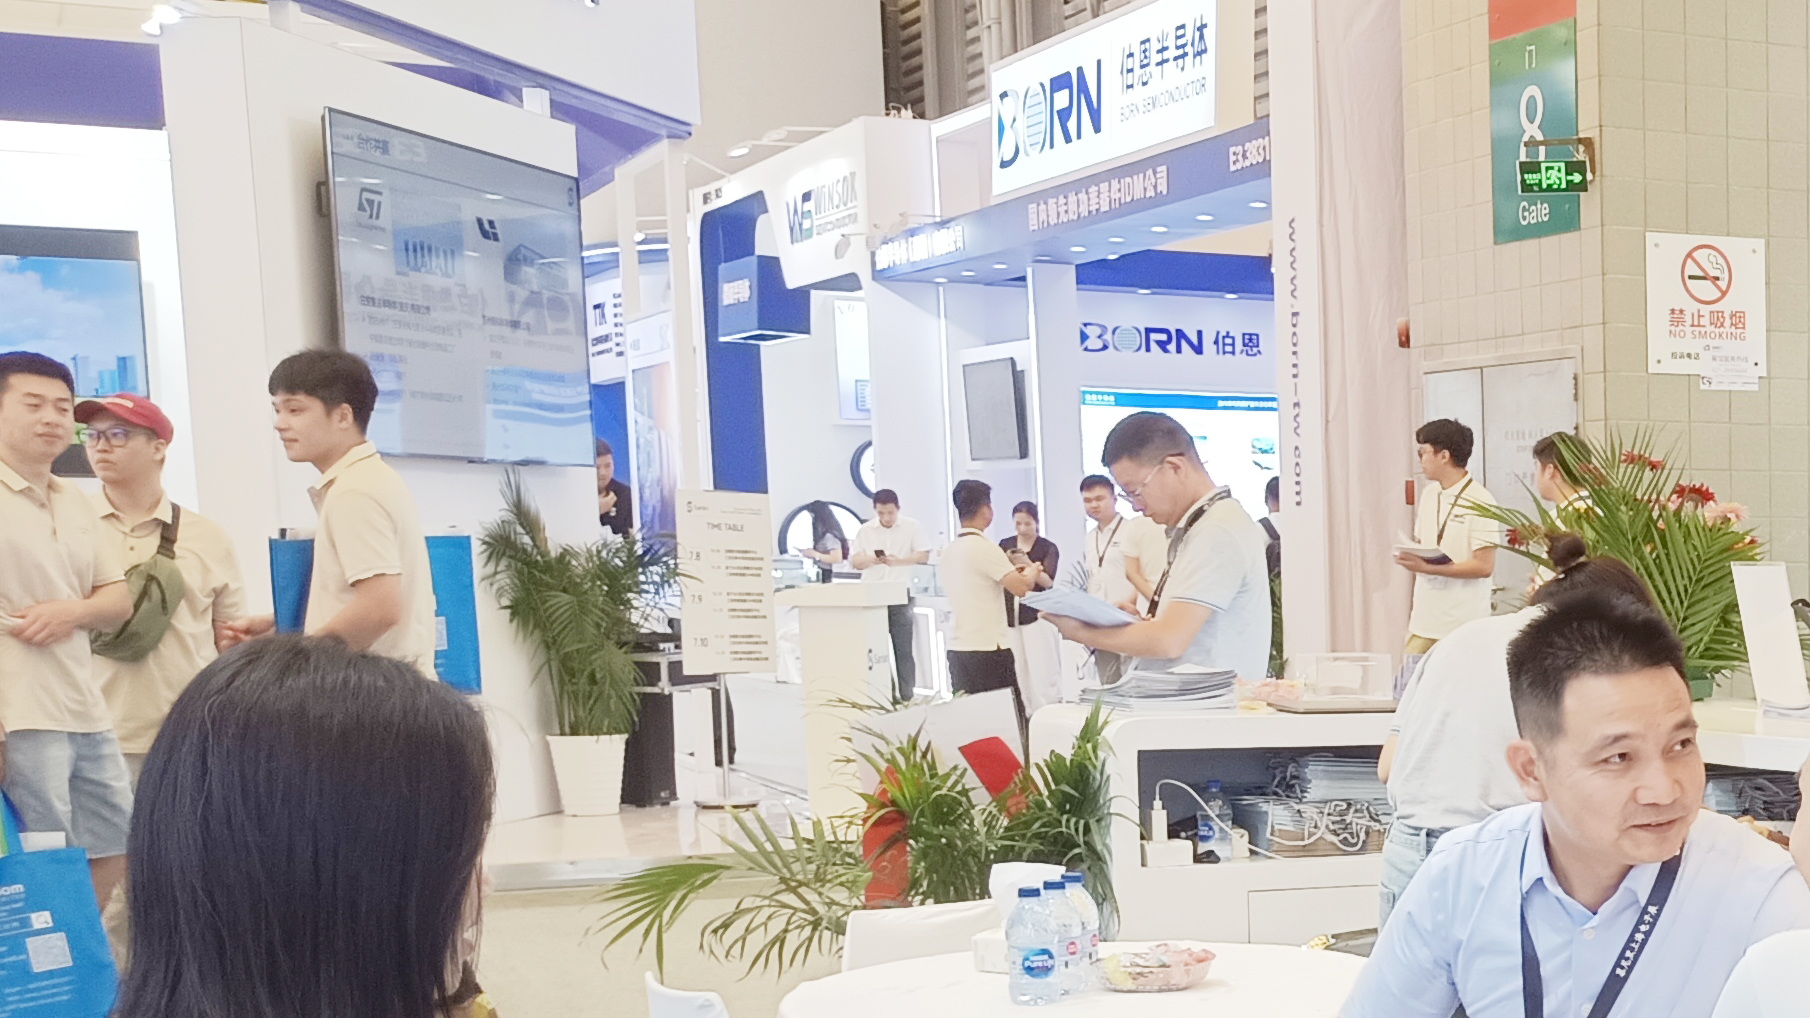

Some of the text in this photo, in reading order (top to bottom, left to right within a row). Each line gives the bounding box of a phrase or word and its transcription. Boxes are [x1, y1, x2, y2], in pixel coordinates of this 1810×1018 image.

[1120, 14, 1208, 96] 伯恩半导体
[1525, 45, 1536, 70] 门
[998, 58, 1102, 169] BORN
[1119, 76, 1207, 123] BORN SEMICONDUCTOR
[1229, 138, 1270, 171] E3.3831
[1027, 164, 1169, 232] 国内领先的功率器件IDM公司
[1519, 201, 1550, 226] Gate
[1668, 308, 1746, 330] 禁止吸烟
[1079, 321, 1204, 356] BORN
[1213, 330, 1263, 357] 伯恩
[1668, 329, 1747, 341] NO SMOKING
[724, 523, 745, 533] TABLE
